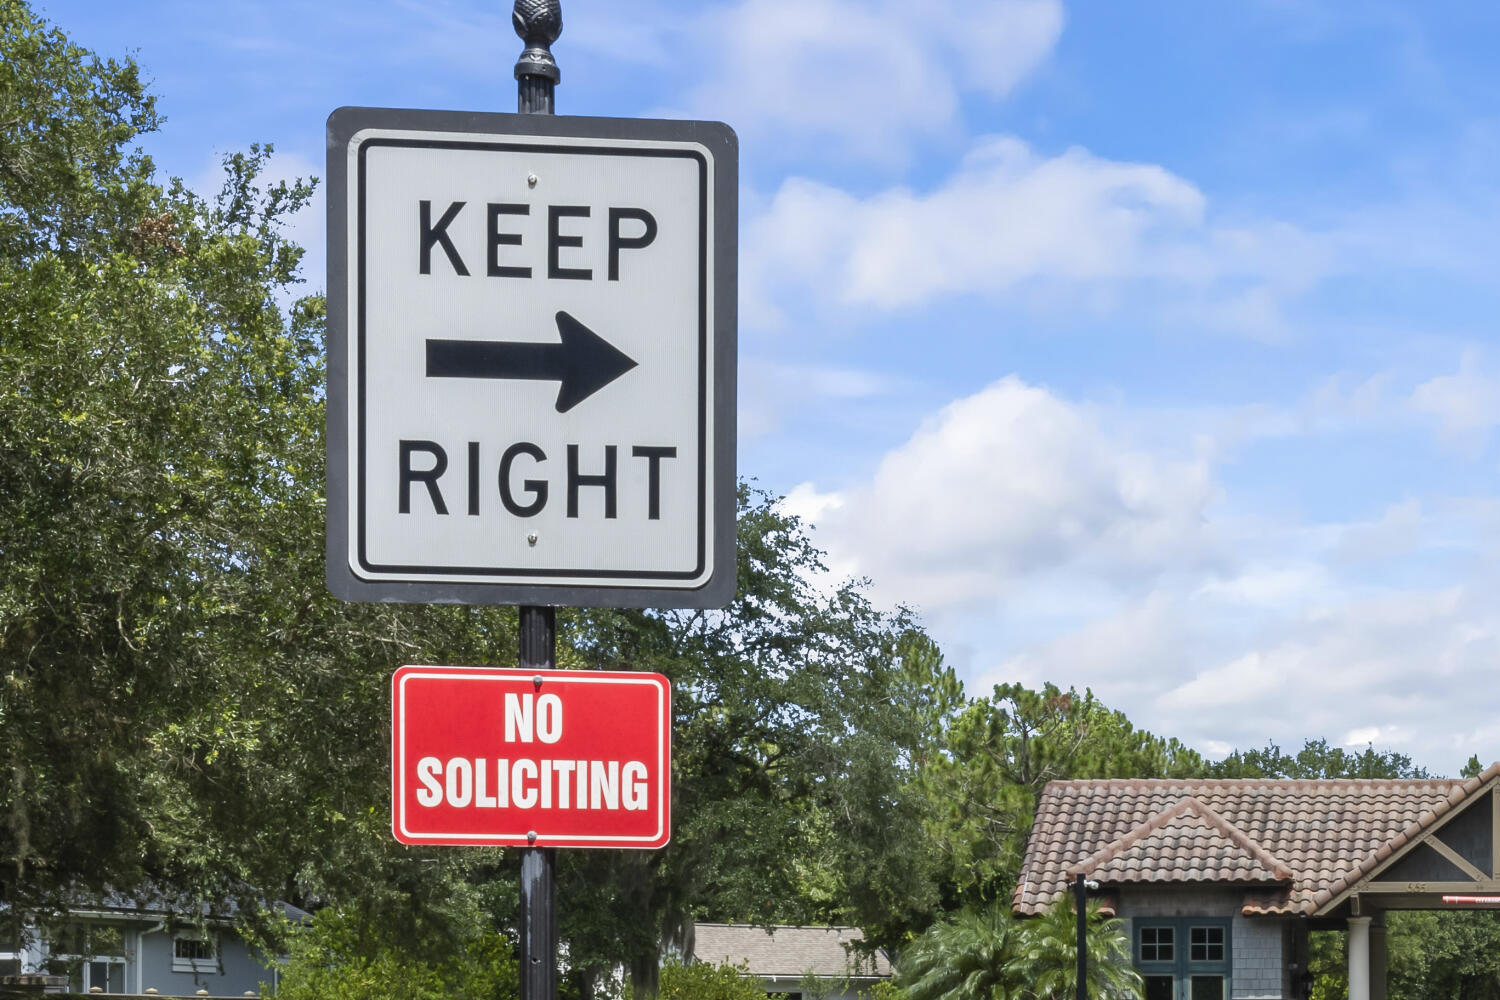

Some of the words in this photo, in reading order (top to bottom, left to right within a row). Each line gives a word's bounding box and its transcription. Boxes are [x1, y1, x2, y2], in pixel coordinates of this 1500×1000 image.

[419, 200, 658, 282] KEEP
[398, 440, 677, 520] RIGHT
[504, 693, 562, 744] NO
[417, 757, 648, 812] SOLICITING
